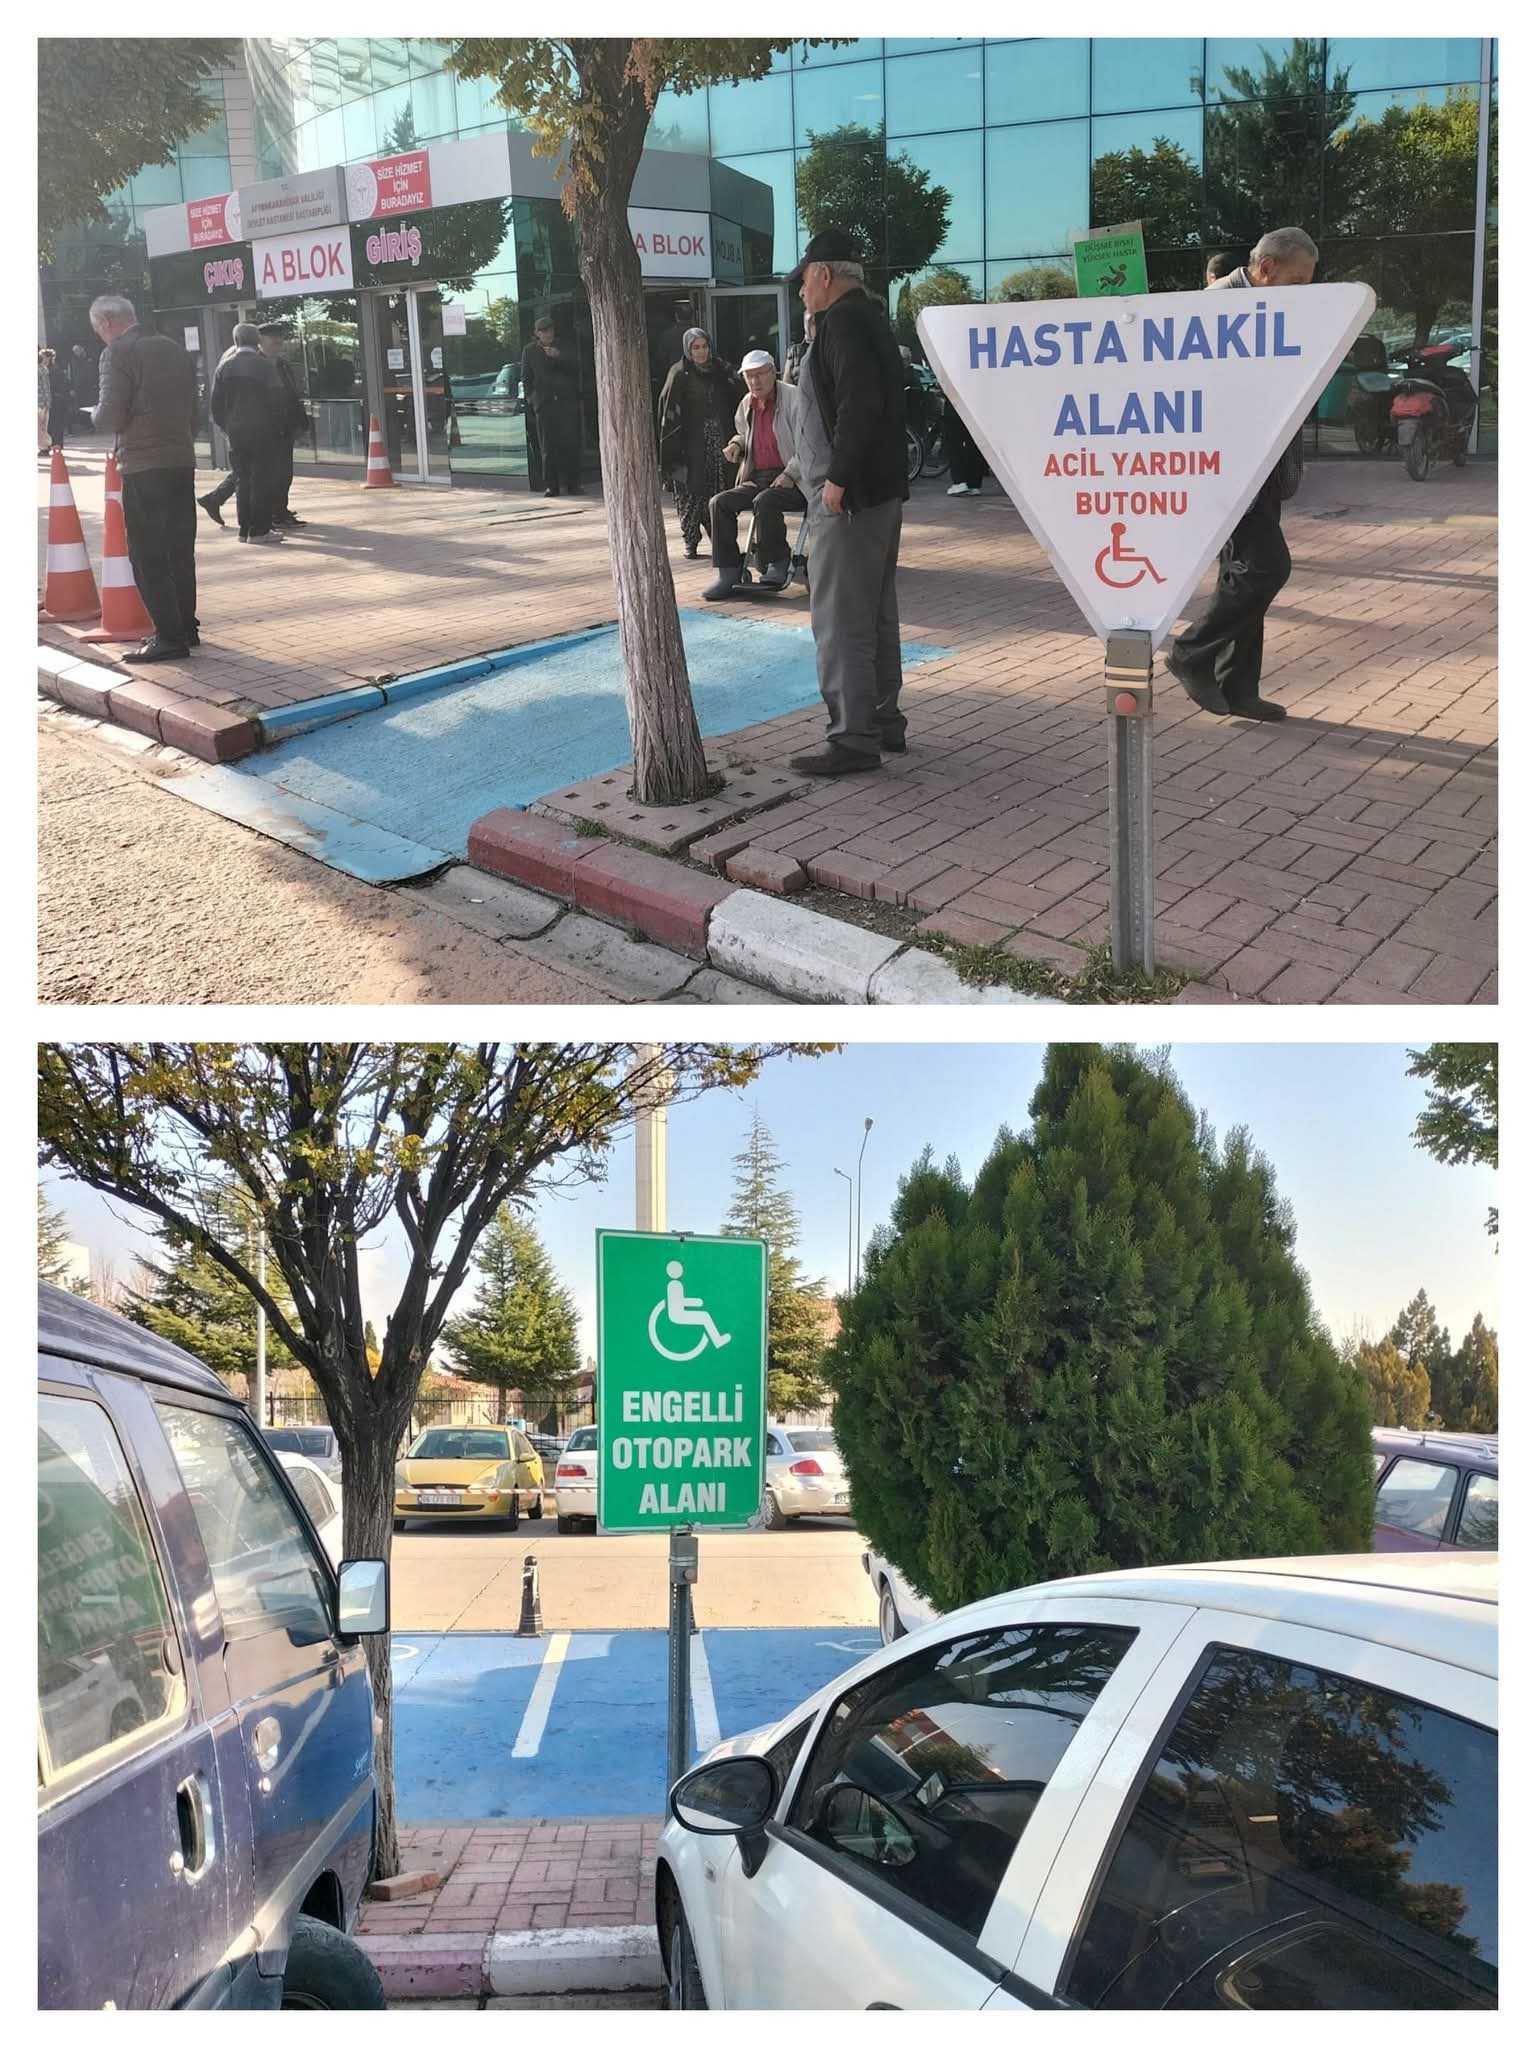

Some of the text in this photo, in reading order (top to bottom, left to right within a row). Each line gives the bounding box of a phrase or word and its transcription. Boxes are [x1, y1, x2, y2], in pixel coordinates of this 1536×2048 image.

[377, 160, 423, 180] SİZE HİZMET
[393, 178, 409, 193] İÇİN
[380, 192, 424, 210] BURADAYIZ
[366, 224, 422, 266] GİRİŞ
[635, 233, 705, 256] A BLOK
[204, 258, 244, 293] ÇIKIŞ
[262, 242, 345, 284] A BLOK
[968, 302, 1301, 369] HASTA NAKİL
[1054, 390, 1203, 436] ALANI
[1044, 447, 1220, 477] ACİL YARDIM
[1076, 491, 1188, 516] BUTONU
[623, 1383, 743, 1423] ENGELLİ
[612, 1436, 752, 1470] OTOPARK
[638, 1482, 726, 1514] ALANI
